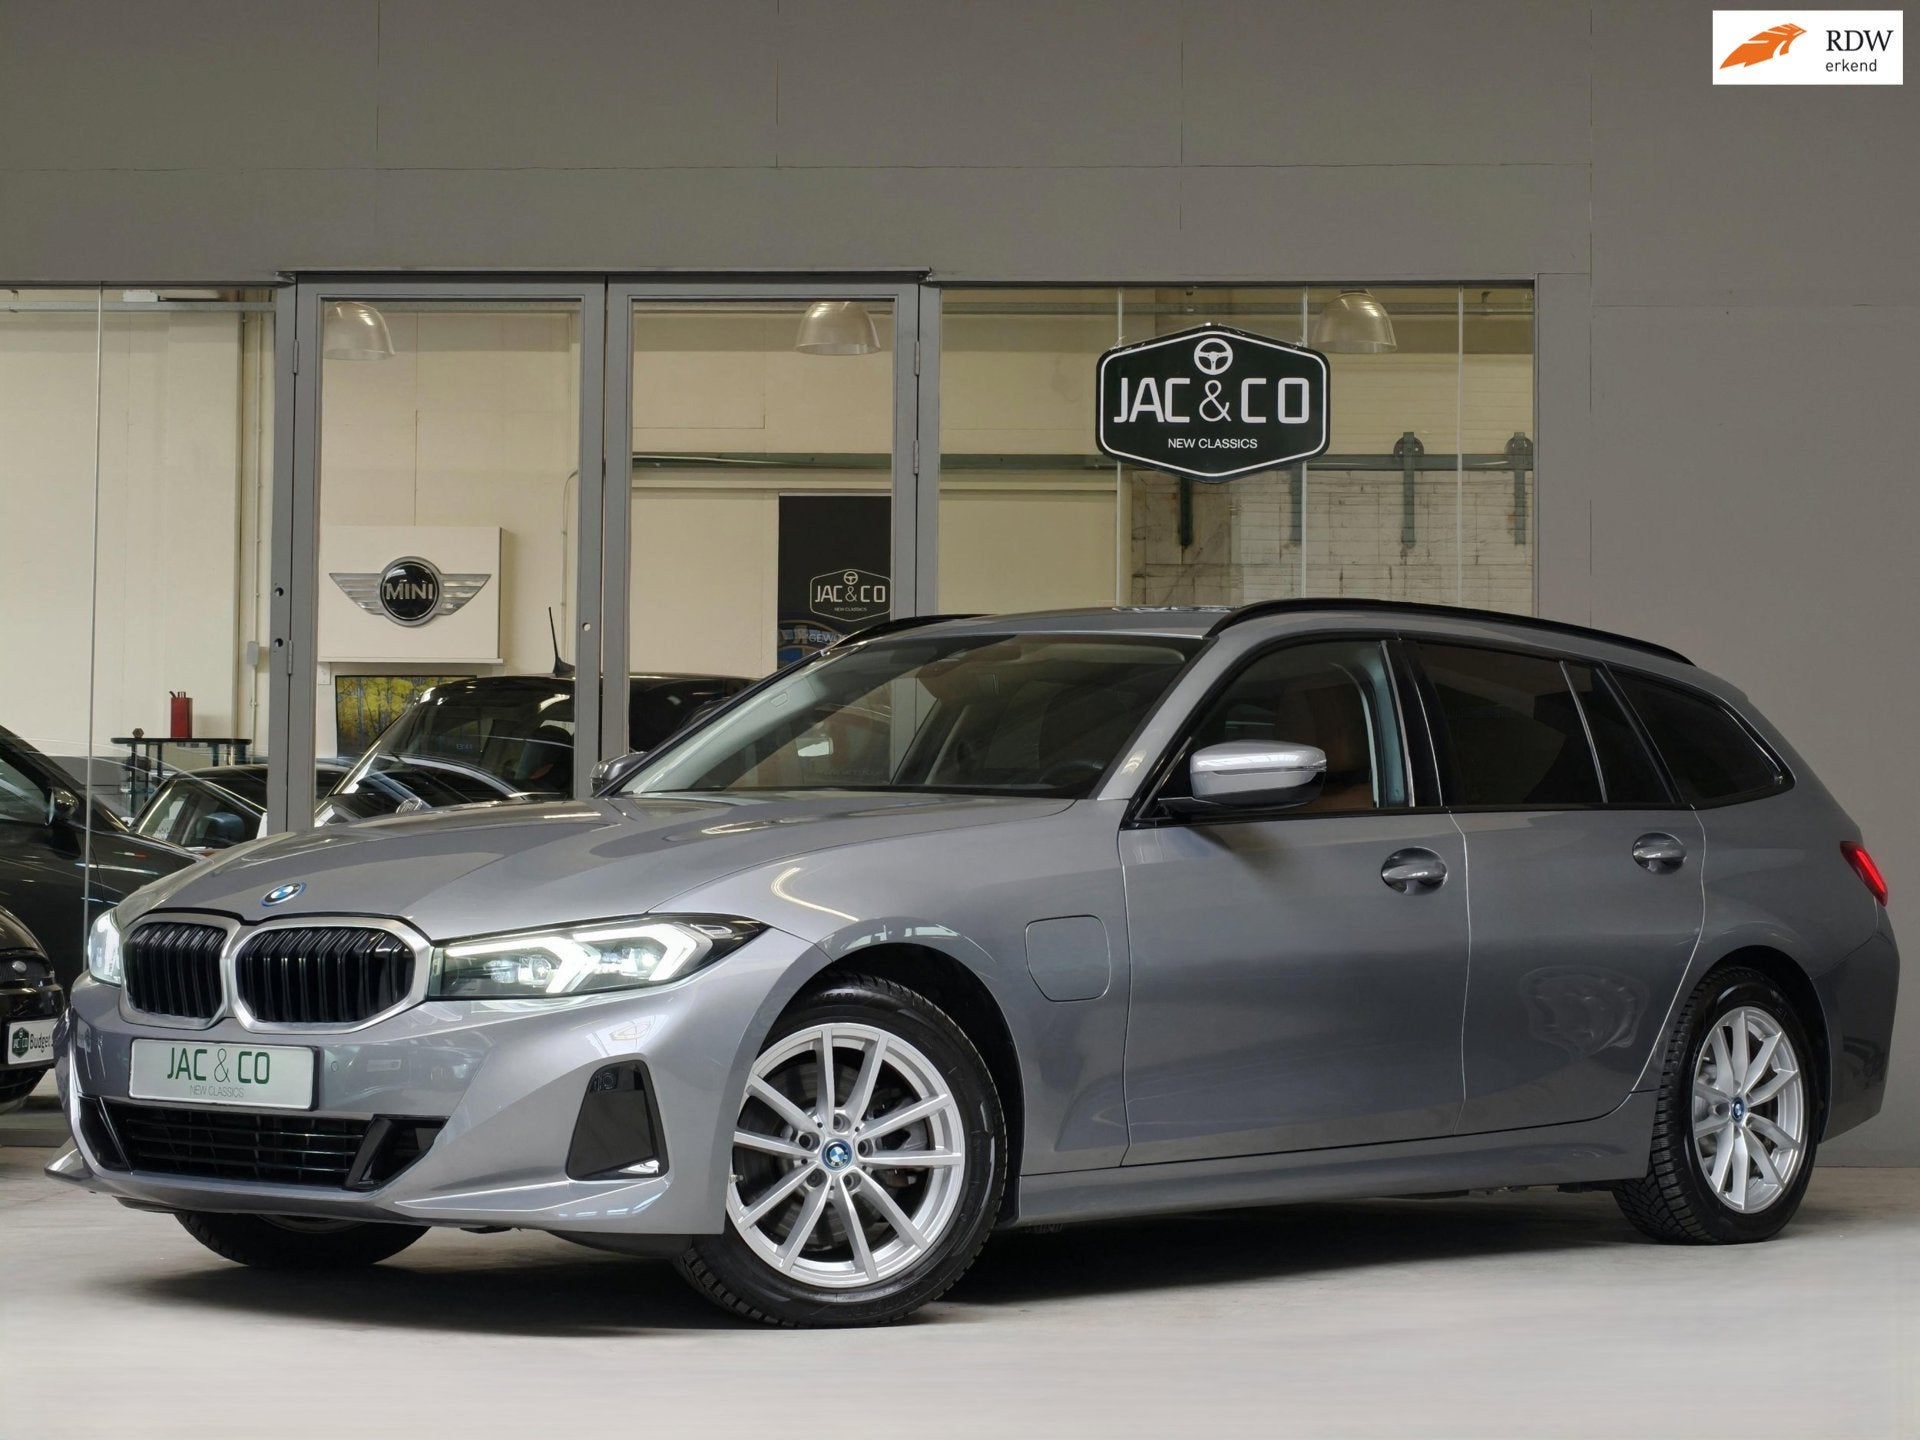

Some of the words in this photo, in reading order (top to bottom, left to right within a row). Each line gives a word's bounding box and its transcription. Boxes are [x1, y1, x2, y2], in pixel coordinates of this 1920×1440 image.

[1113, 377, 1191, 423] JAC
[1198, 379, 1232, 422] &
[1240, 377, 1310, 424] CO
[1167, 438, 1196, 449] NEW
[1198, 438, 1258, 449] CLASSICS
[385, 583, 434, 600] MINI
[814, 585, 843, 603] JAC
[845, 586, 858, 602] &
[860, 585, 886, 603] CO
[167, 1047, 208, 1082] JAC
[213, 1048, 231, 1083] &
[237, 1051, 271, 1085] CO
[189, 1084, 207, 1096] NEW
[208, 1085, 245, 1098] CLASSICS
